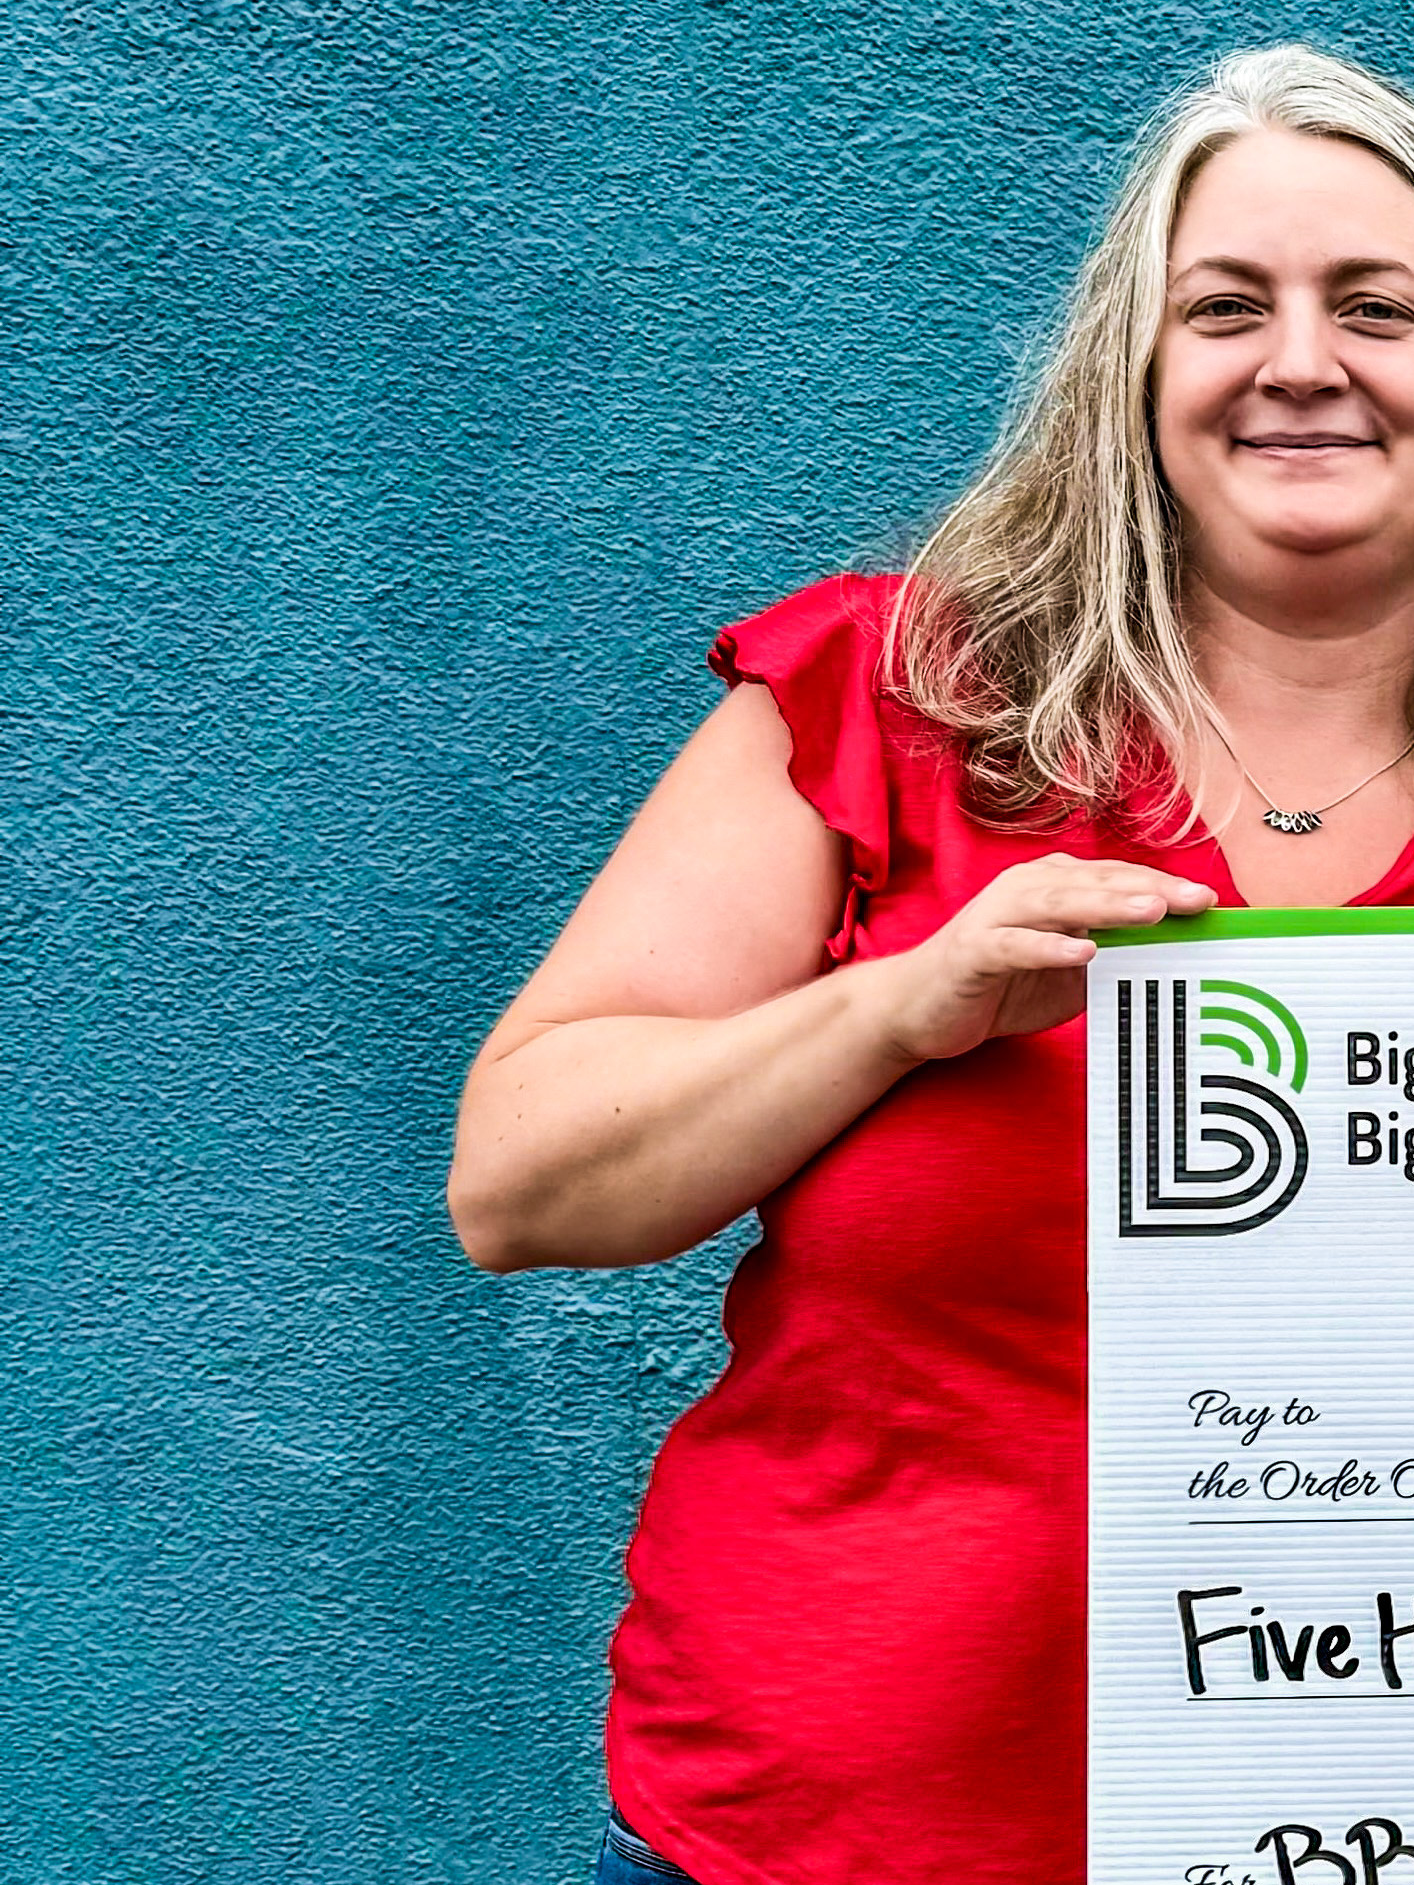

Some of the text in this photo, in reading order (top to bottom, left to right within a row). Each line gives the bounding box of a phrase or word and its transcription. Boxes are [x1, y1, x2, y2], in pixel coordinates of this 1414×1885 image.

[1187, 1389, 1321, 1447] Pay to
[1187, 1460, 1250, 1500] the
[1259, 1459, 1381, 1502] Order
[1177, 1586, 1359, 1696] Five
